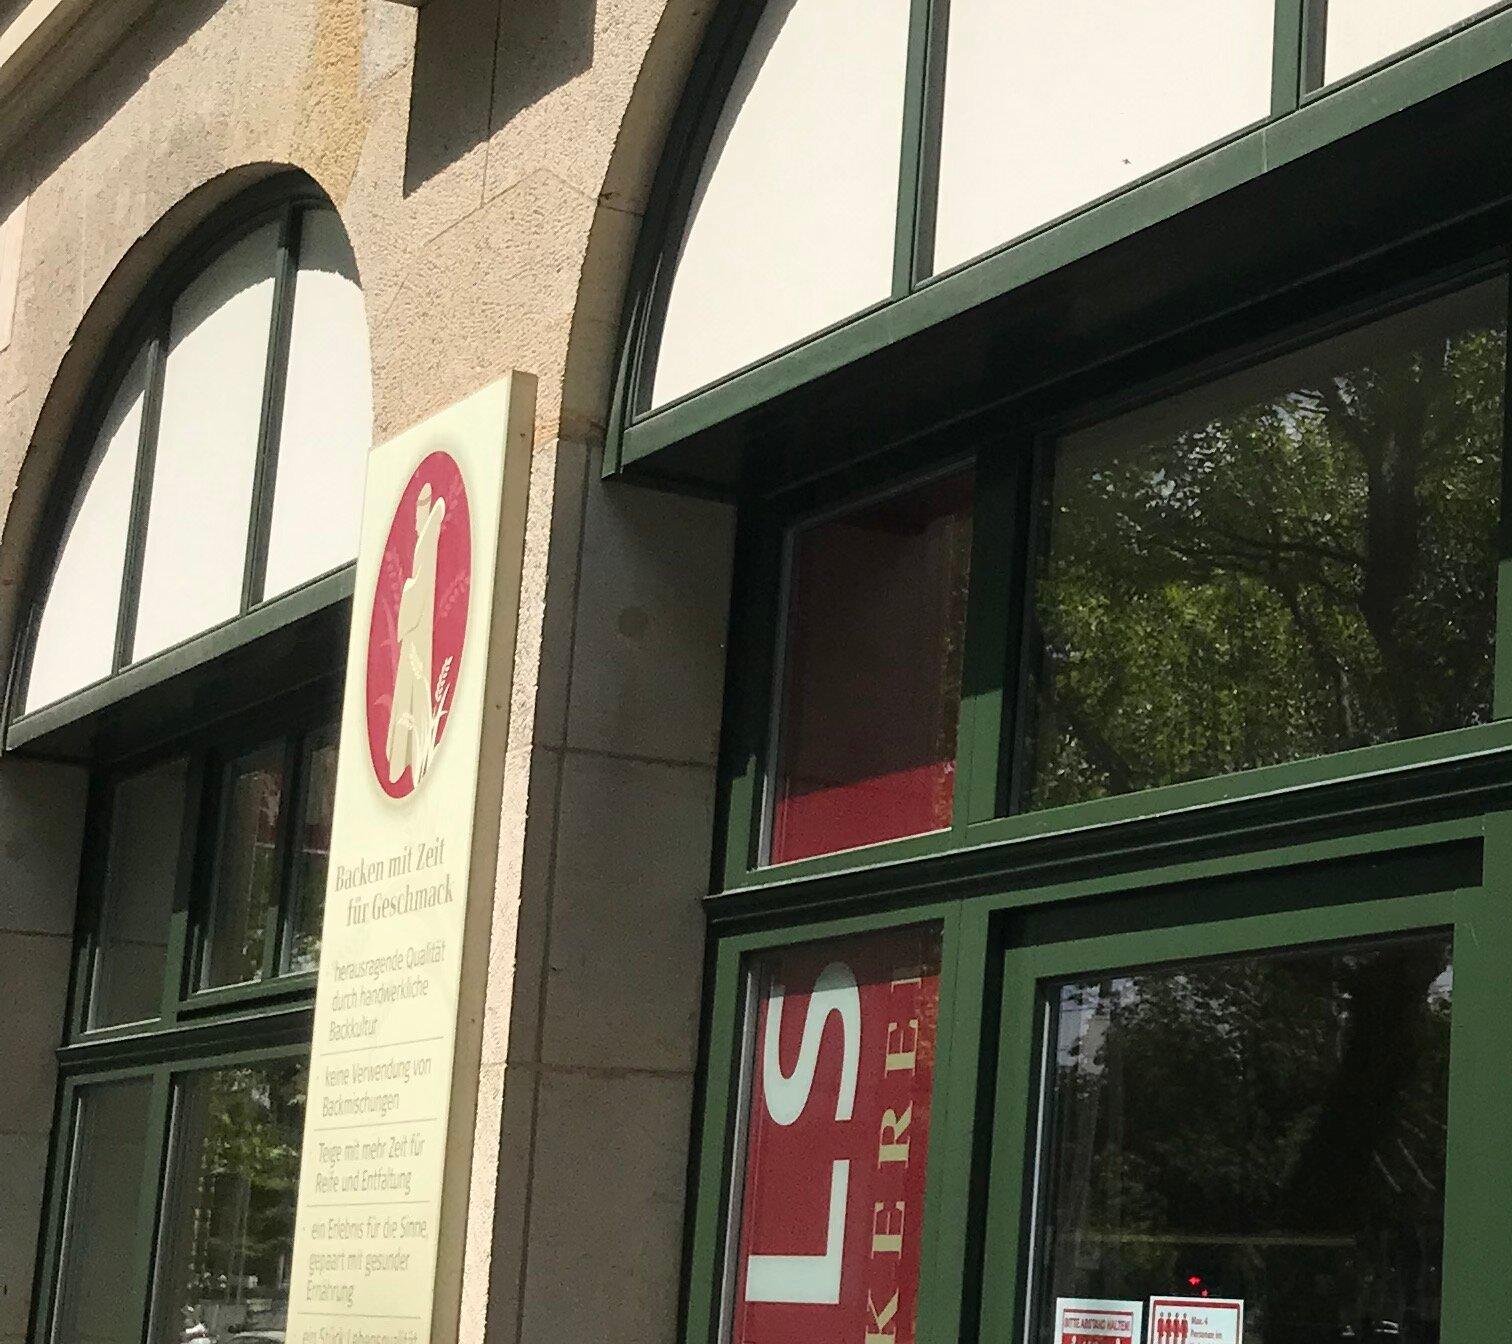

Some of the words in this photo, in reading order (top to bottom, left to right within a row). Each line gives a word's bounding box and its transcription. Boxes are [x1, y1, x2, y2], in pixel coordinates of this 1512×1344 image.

[334, 857, 384, 893] Backen
[388, 846, 412, 879] mit
[415, 837, 445, 872] Zeit
[346, 896, 369, 927] für
[372, 873, 454, 921] Geschmack
[334, 948, 403, 983] herausragende
[405, 939, 446, 971] Qualität
[332, 988, 358, 1012] durch
[360, 974, 429, 1008] handwerkliche
[329, 1014, 378, 1042] Backkultur
[325, 1064, 350, 1088] keine
[351, 1056, 411, 1084] Verwendung
[413, 1056, 432, 1076] von
[322, 1091, 401, 1119] Backmischungen
[318, 1141, 342, 1168] Teige
[344, 1142, 360, 1162] mit
[362, 1136, 387, 1160] mehr
[388, 1135, 408, 1159] Zeit
[410, 1132, 426, 1157] für
[315, 1170, 340, 1194] Reife
[341, 1170, 360, 1192] und
[361, 1166, 412, 1196] Entfaltung
